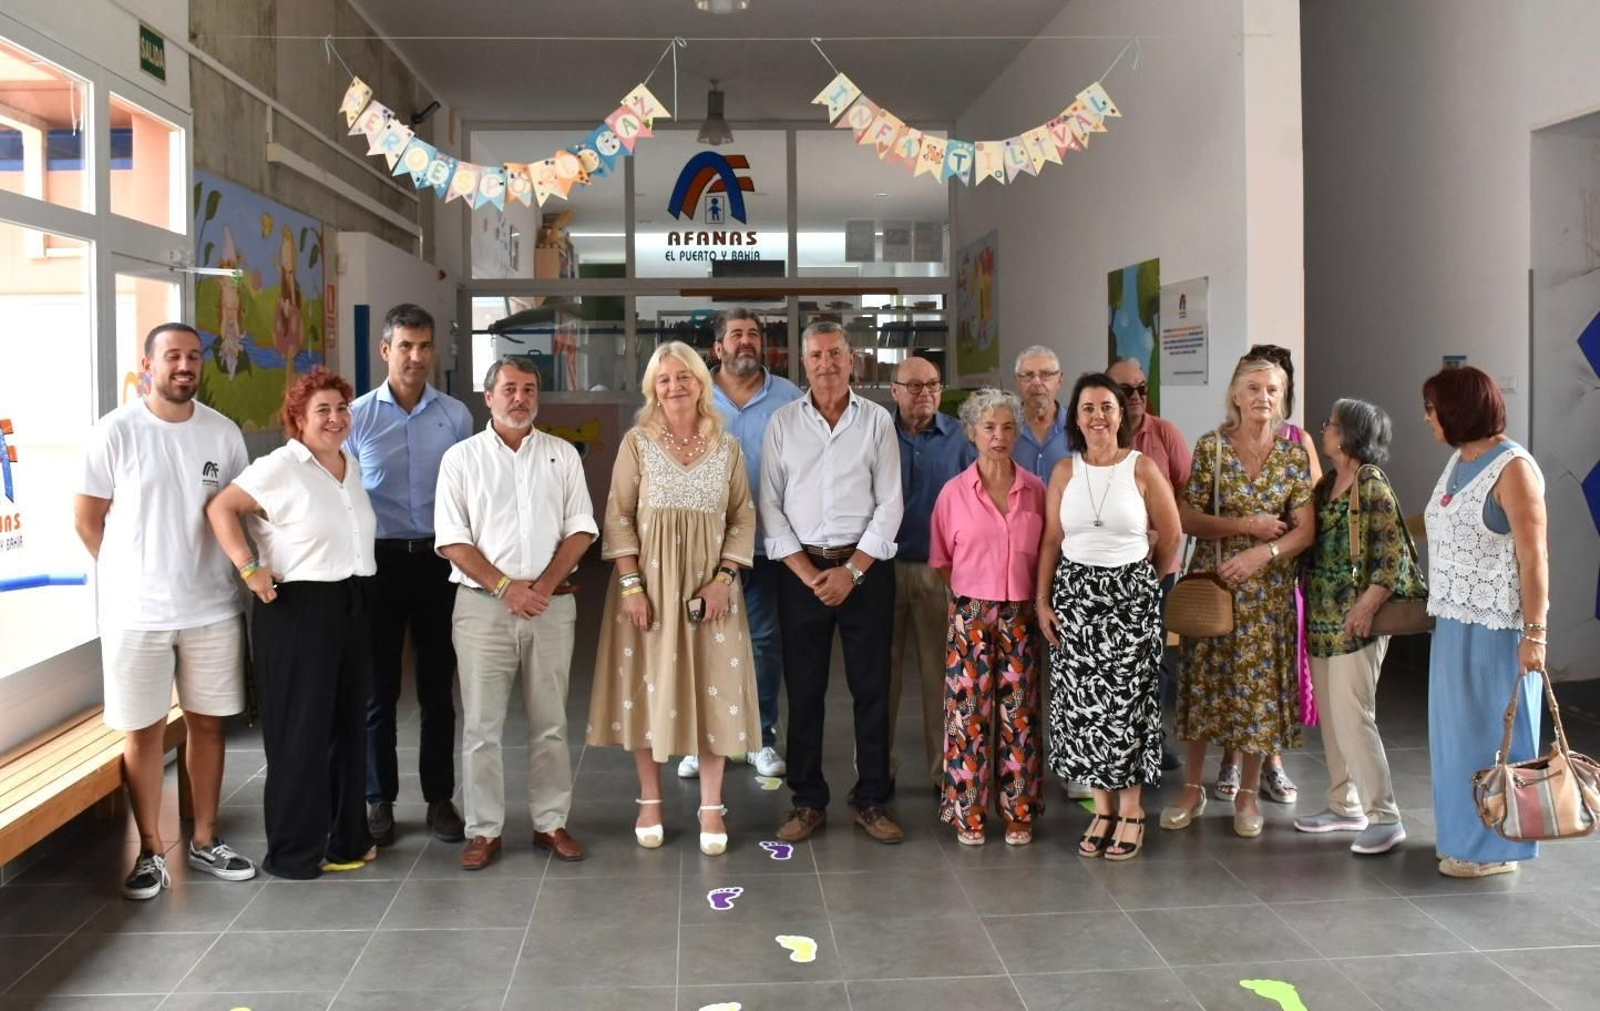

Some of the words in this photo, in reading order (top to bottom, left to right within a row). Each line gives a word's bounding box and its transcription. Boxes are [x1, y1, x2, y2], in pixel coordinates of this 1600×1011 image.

[141, 35, 165, 70] SALIDA
[668, 231, 757, 246] AFANAS
[665, 250, 676, 261] EL
[679, 250, 717, 262] PUERTO
[721, 250, 727, 261] Y
